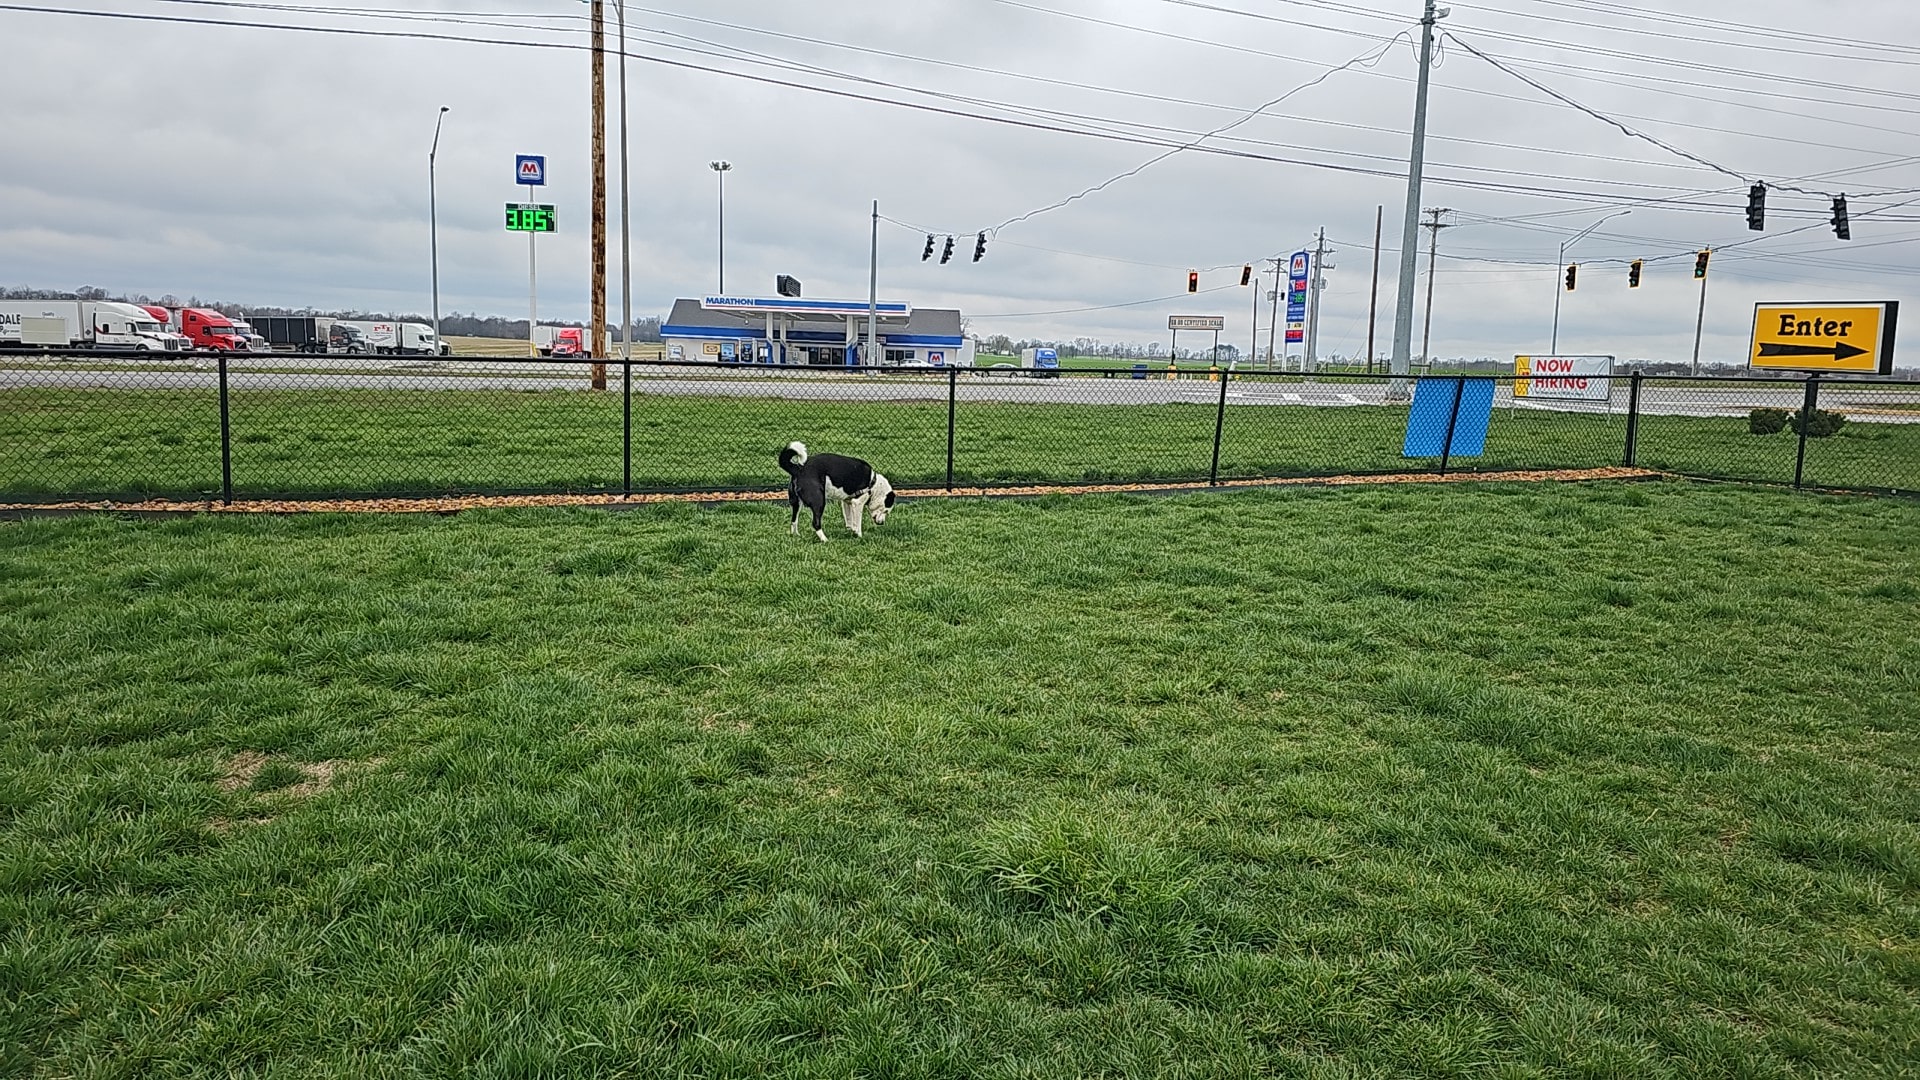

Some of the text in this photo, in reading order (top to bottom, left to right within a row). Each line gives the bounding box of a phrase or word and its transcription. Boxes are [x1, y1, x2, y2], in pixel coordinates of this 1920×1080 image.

[522, 163, 537, 173] M
[1294, 258, 1303, 269] M
[705, 297, 754, 306] MARATHON
[1777, 314, 1852, 336] Enter
[931, 354, 941, 362] M
[1536, 360, 1573, 373] NOW
[1535, 376, 1587, 389] HIRING
